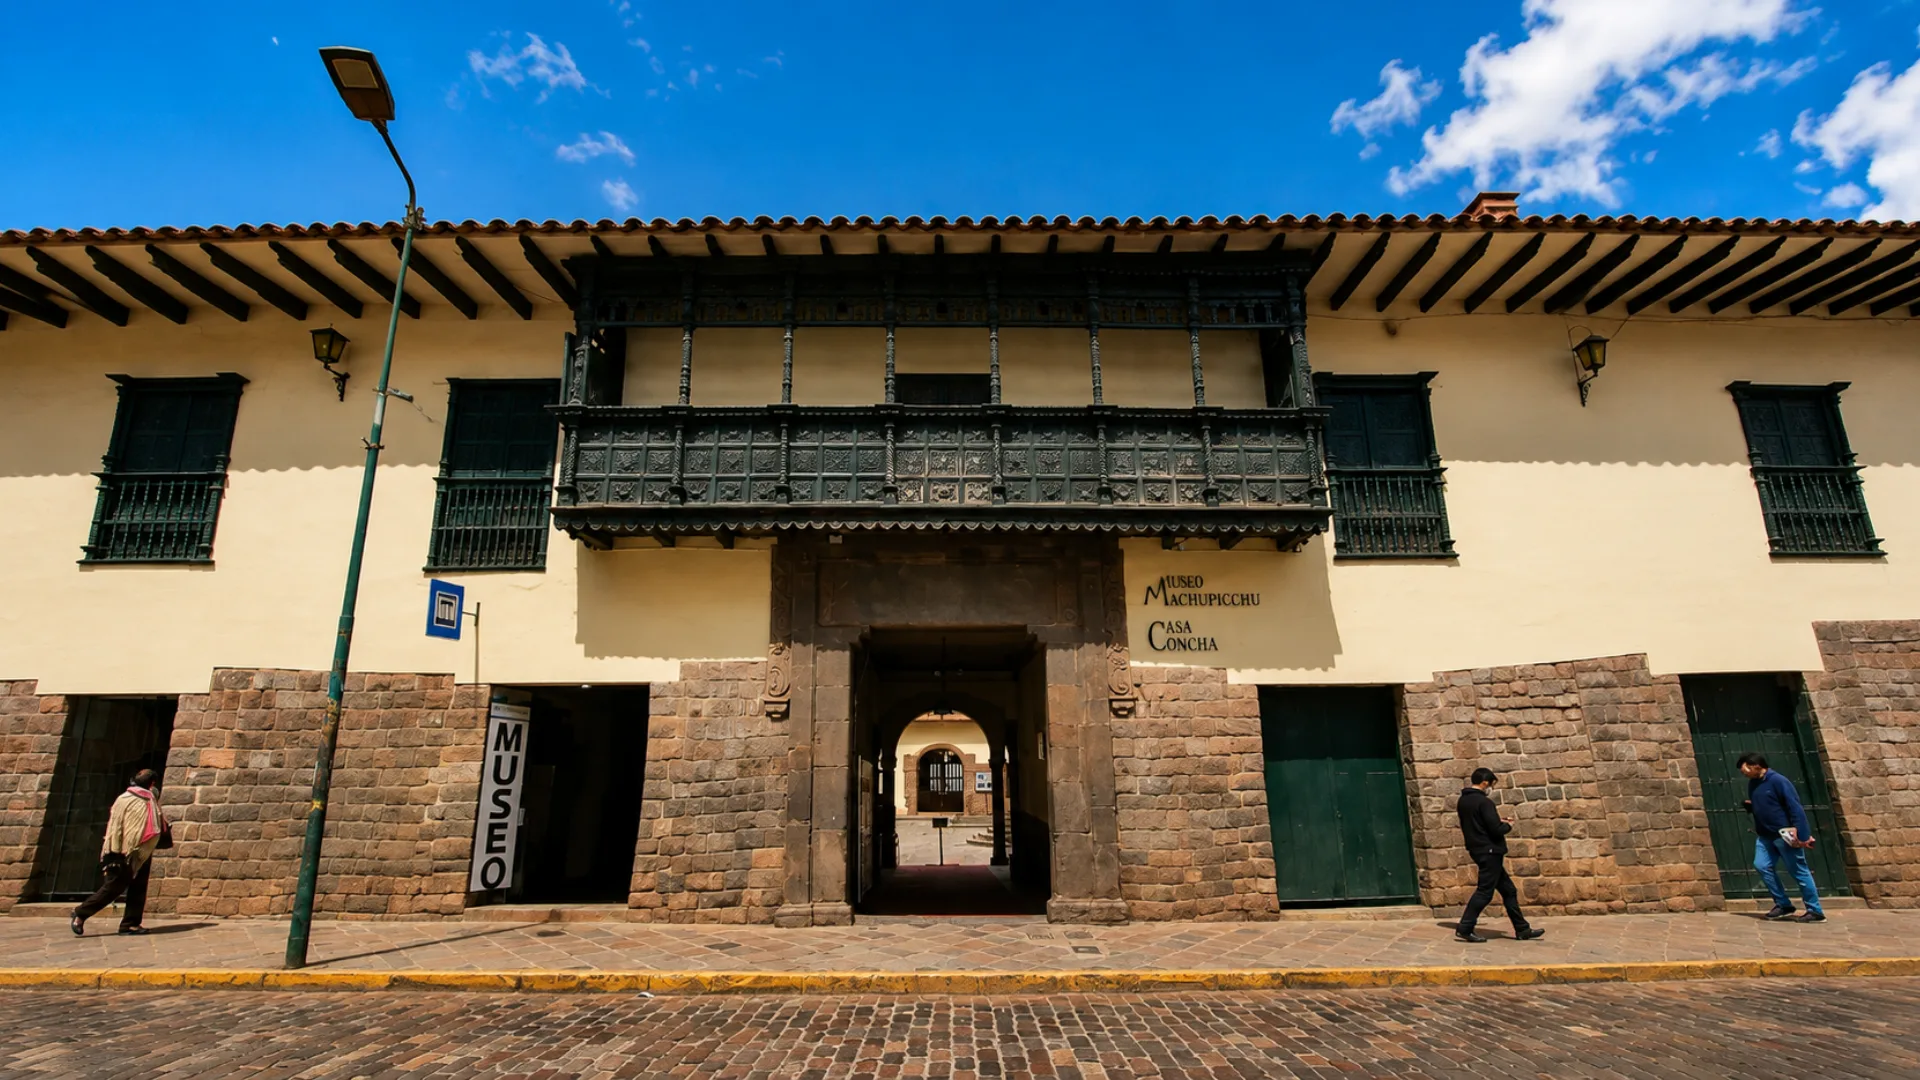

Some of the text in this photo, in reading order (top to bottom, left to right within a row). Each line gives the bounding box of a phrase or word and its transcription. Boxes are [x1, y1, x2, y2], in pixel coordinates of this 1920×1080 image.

[1144, 576, 1260, 606] MACHUPICCHU
[1148, 620, 1218, 651] CONCHA
[480, 722, 523, 889] MUSEO
